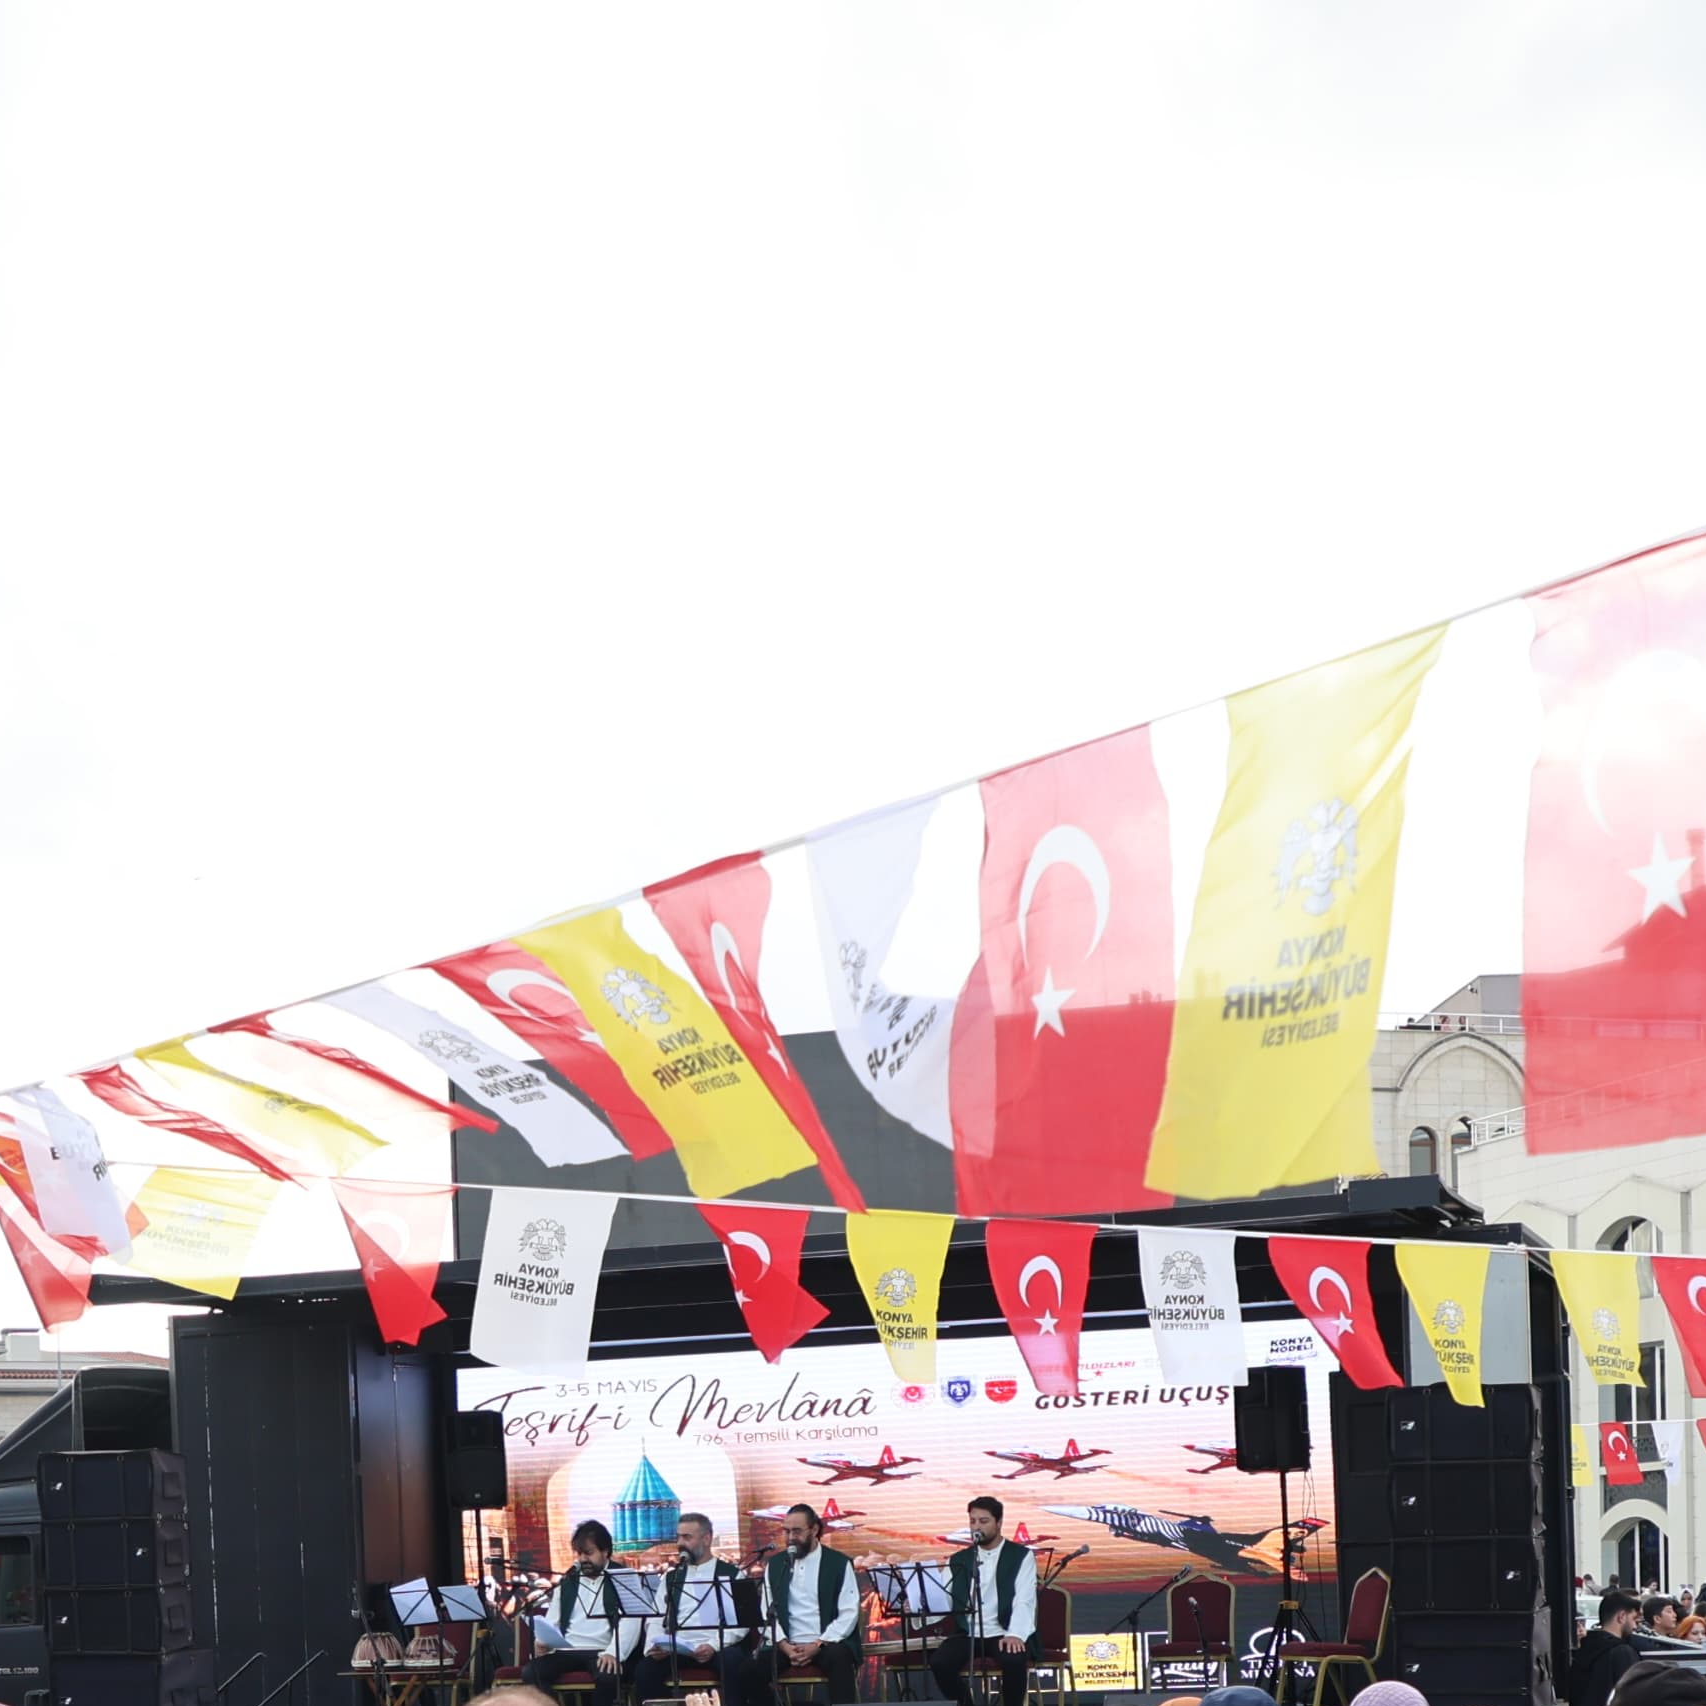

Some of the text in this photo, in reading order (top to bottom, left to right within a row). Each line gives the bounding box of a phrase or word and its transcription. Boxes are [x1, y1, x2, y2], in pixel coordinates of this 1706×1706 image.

[876, 1309, 913, 1323] KONYA
[1270, 1336, 1312, 1346] KONYA
[555, 1379, 658, 1397] 3-5 MAYIS
[1035, 1385, 1230, 1409] GÖSTERİ UÇUŞ
[649, 1372, 878, 1438] Mevlânâ
[693, 1434, 727, 1446] 796.
[796, 1426, 878, 1440] Karşılama
